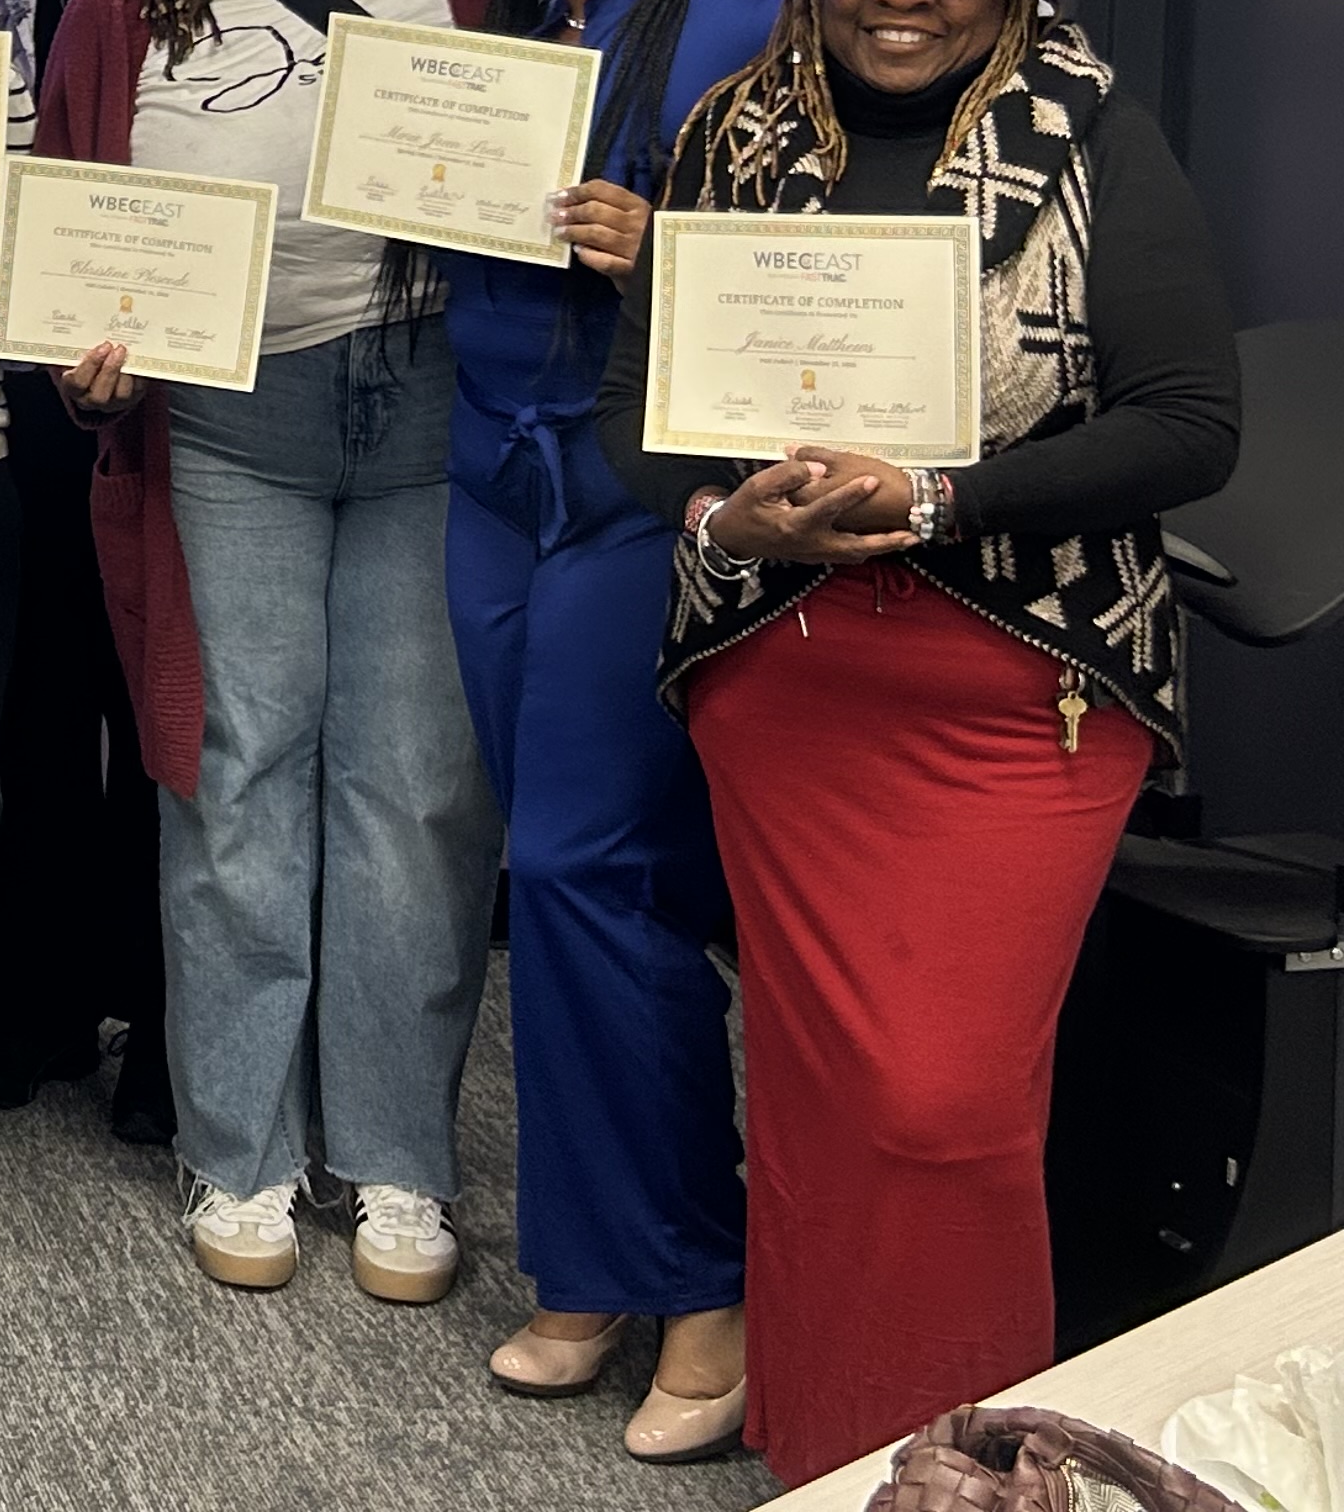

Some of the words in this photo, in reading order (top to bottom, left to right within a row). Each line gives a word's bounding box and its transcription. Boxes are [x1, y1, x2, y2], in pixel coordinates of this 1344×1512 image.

[374, 89, 439, 108] CERTIFICATE
[442, 99, 456, 110] OF
[458, 102, 530, 122] COMPLETION
[53, 226, 121, 243] CERTIFICATE
[124, 234, 138, 244] OF
[141, 236, 213, 254] COMPLETION
[69, 259, 130, 280] Christine
[717, 293, 795, 307] CERTIFICATE
[798, 296, 813, 307] OF
[817, 297, 904, 310] COMPLETION
[736, 330, 794, 354] Janice
[796, 334, 875, 353] Matthews
